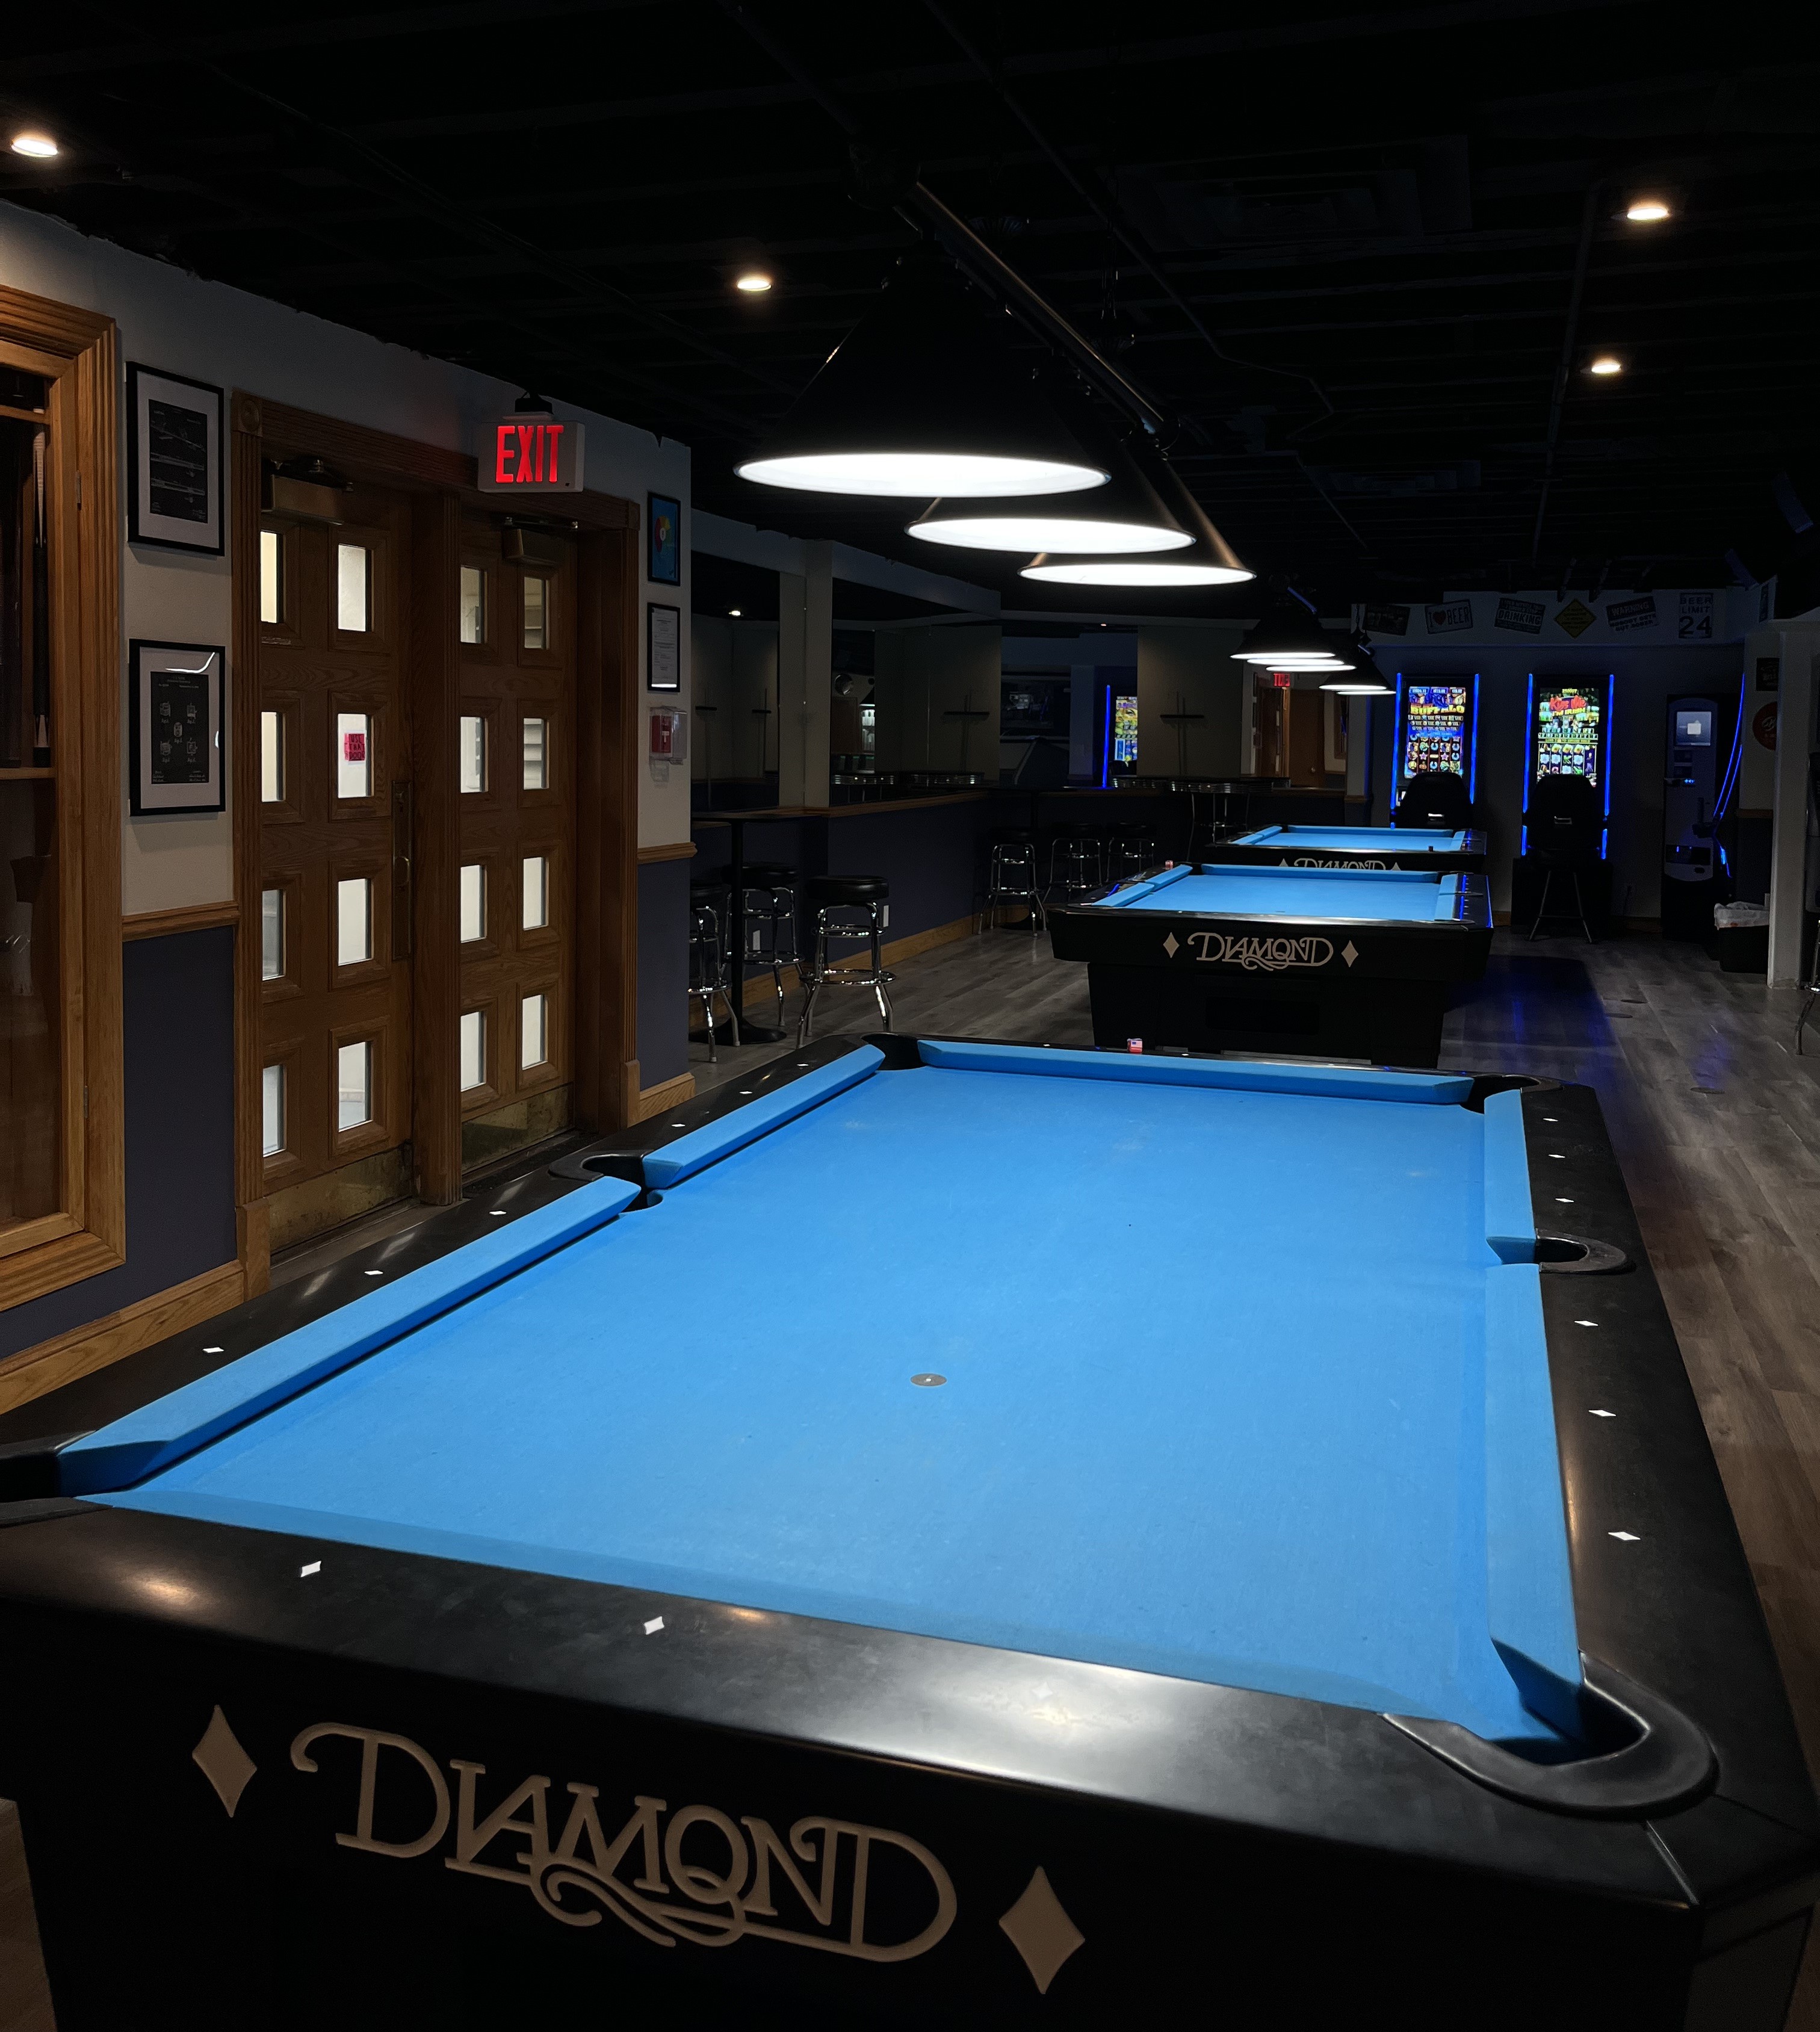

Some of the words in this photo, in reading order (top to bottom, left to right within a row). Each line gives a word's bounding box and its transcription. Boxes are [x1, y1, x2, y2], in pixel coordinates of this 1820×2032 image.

[495, 424, 564, 484] EXIT
[1680, 596, 1713, 605] BEER
[1447, 606, 1470, 625] BEER
[1498, 610, 1541, 625] DRINKING
[1679, 615, 1712, 635] 24
[351, 734, 363, 743] USE
[1187, 931, 1334, 971] DIAMOND
[289, 1721, 958, 1963] DIAMOND
